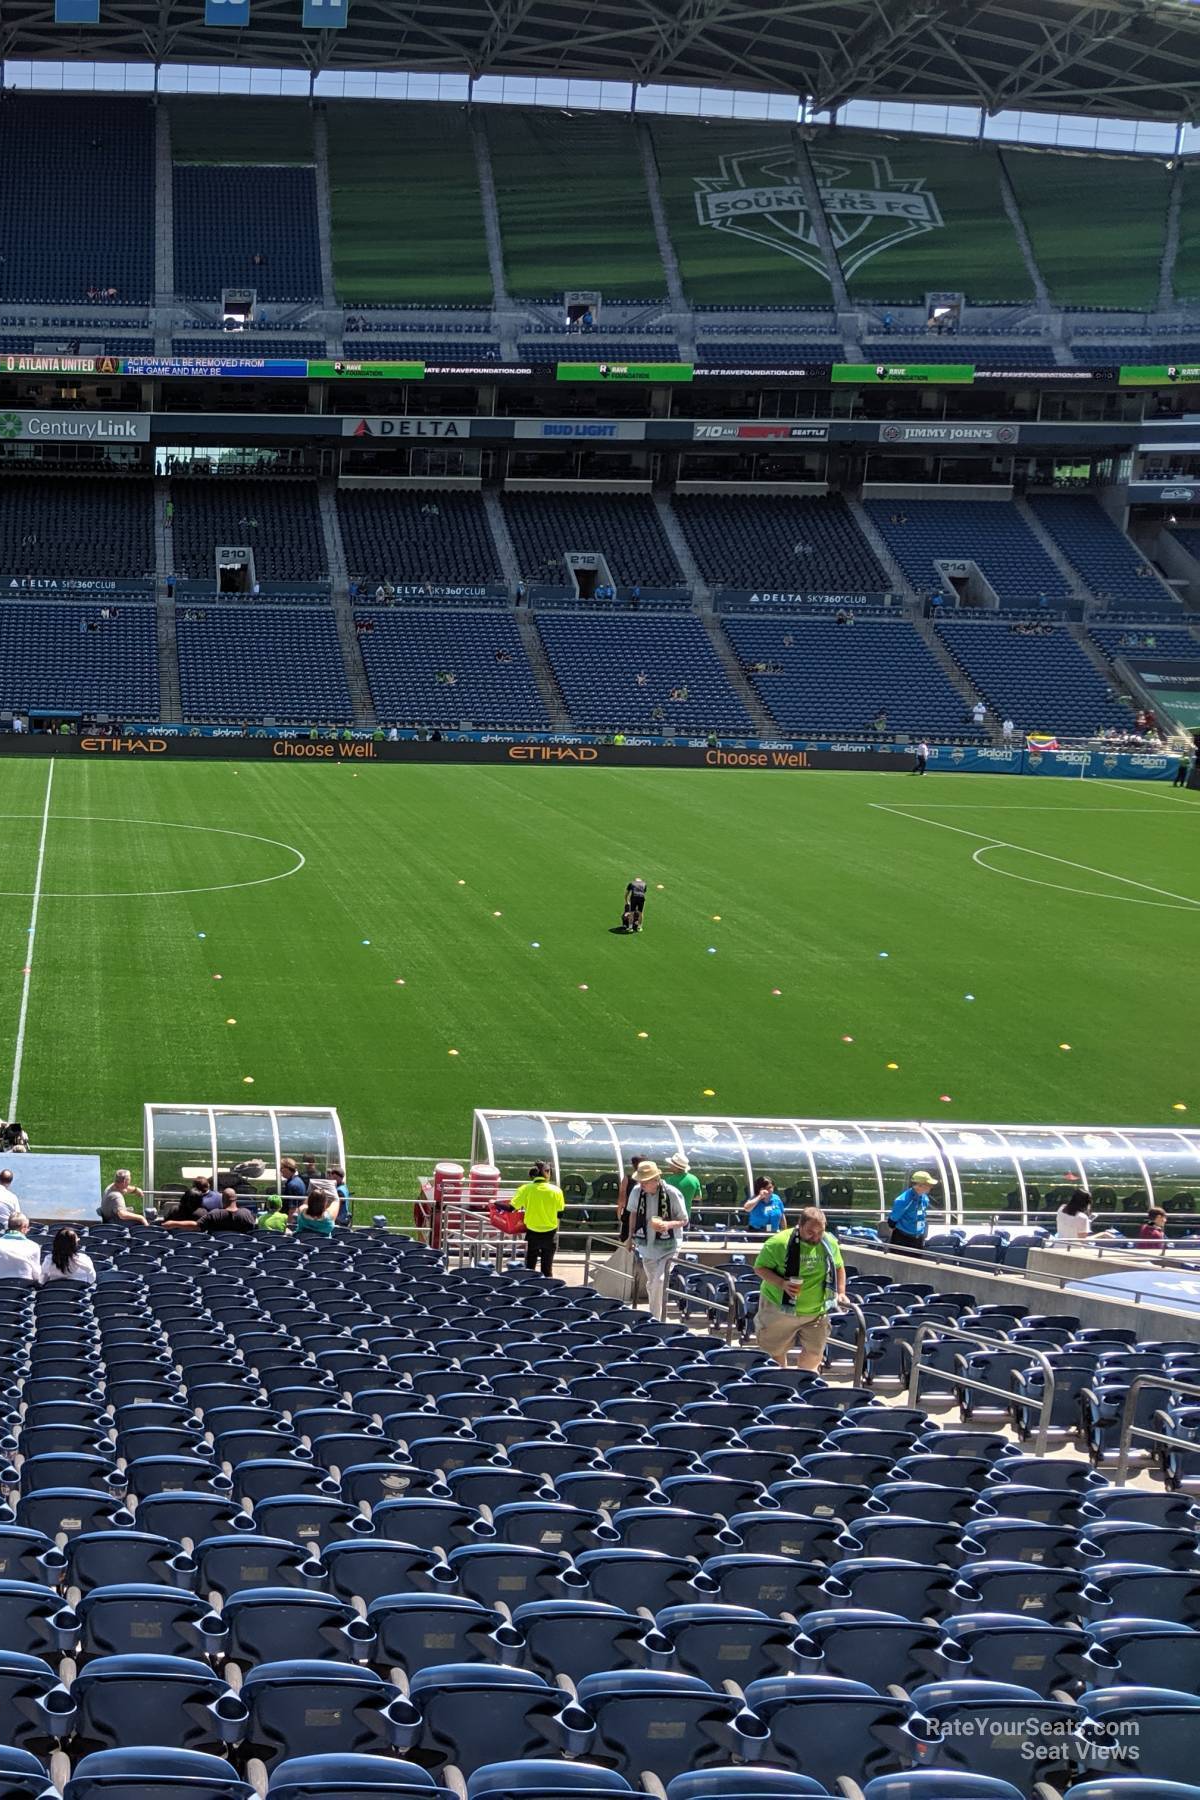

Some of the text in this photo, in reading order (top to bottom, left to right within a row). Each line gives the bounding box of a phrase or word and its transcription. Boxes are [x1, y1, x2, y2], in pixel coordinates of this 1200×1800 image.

[886, 201, 924, 216] FC
[228, 289, 252, 298] 310
[7, 355, 94, 372] 0 ATLANTA UNITED
[127, 358, 265, 368] ACTION WILL BE REMOVED FROM
[127, 366, 221, 376] THE GAME AND MAY BE
[888, 368, 906, 376] RAVE
[28, 418, 137, 439] CenturyLink
[380, 420, 458, 436] DELTA
[543, 424, 616, 437] BUD LIGHT
[696, 426, 722, 437] 710
[791, 429, 826, 437] SEATTLE
[904, 428, 993, 440] JIMMY JOHN'S
[221, 550, 246, 558] 210
[570, 555, 595, 564] 212
[940, 562, 966, 571] 214
[763, 593, 802, 602] DELTA
[80, 738, 167, 752] ETIHAD
[273, 741, 378, 758] Choose Well.
[759, 740, 793, 750] slalom
[831, 743, 866, 753] slalom
[509, 747, 598, 761] ETIHAD
[977, 748, 1013, 758] slalom
[706, 750, 811, 767] Choose Well.
[1130, 756, 1168, 766] slalom
